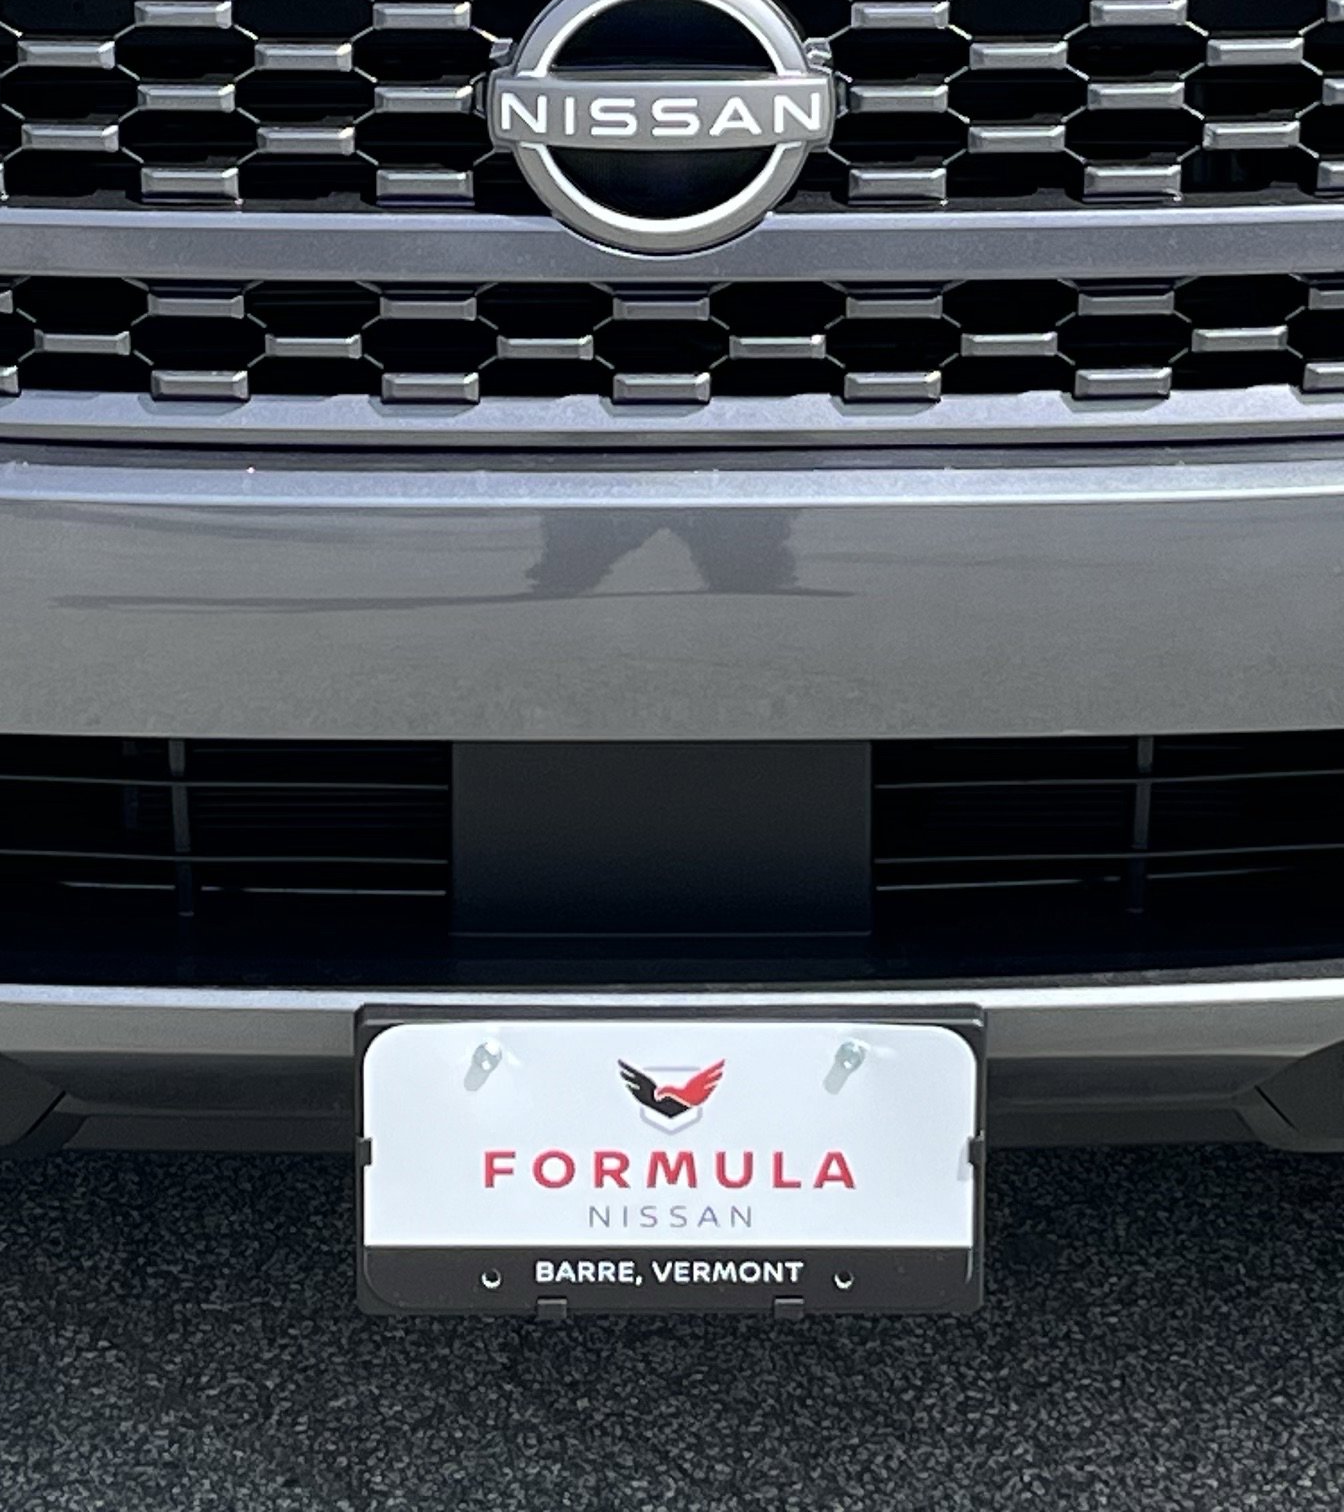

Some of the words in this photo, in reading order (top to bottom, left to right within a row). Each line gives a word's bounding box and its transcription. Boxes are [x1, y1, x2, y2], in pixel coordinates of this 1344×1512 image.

[500, 91, 822, 137] NISSAN
[482, 1149, 858, 1190] FORMULA
[588, 1205, 754, 1229] NISSAN
[534, 1260, 644, 1287] BARRE,
[652, 1260, 804, 1285] VERMONT
